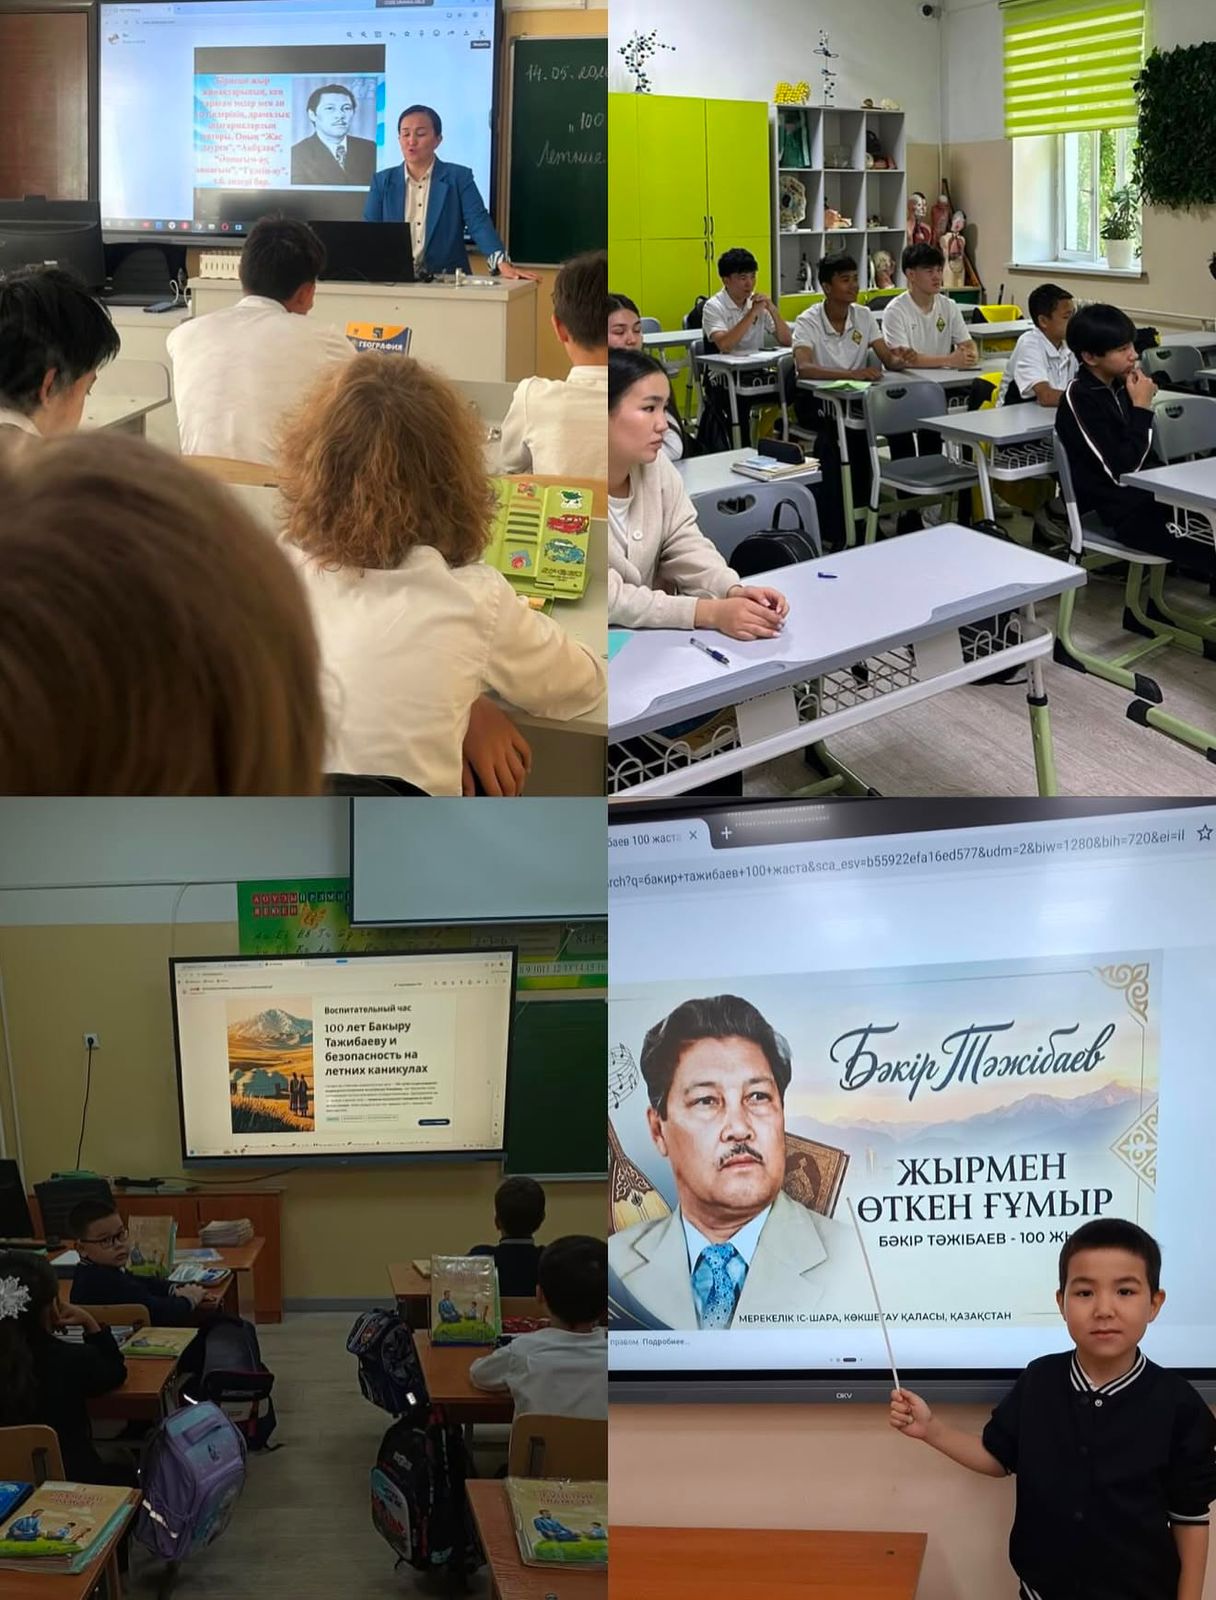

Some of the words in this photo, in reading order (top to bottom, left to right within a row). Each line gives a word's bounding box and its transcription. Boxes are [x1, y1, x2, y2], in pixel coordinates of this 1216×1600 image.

[633, 834, 650, 846] 100
[324, 1004, 395, 1014] Воспитательный
[325, 1024, 344, 1033] 100
[346, 1024, 366, 1032] лет
[369, 1022, 411, 1033] Бакыру
[325, 1036, 387, 1048] Тажибаеву
[390, 1037, 397, 1045] и
[325, 1052, 401, 1062] безопасность
[404, 1051, 418, 1060] на
[830, 1021, 940, 1102] Бәкір
[931, 1019, 1116, 1092] Тәжібаев
[325, 1067, 366, 1076] летних
[368, 1065, 428, 1076] каникулах
[897, 1153, 1067, 1186] ЖЫРМЕН
[857, 1193, 972, 1222] ӨТКЕН
[984, 1188, 1113, 1219] ҒҰМЫР
[879, 1234, 923, 1248] БӘКІР
[928, 1232, 1006, 1246] ТӘЖІБАЕВ
[1020, 1231, 1045, 1244] 100
[739, 1313, 794, 1323] МЕРЕКЕЛІК
[901, 1312, 947, 1323] ҚАЛАСЫ,
[950, 1312, 1011, 1322] ҚАЗАҚСТАН
